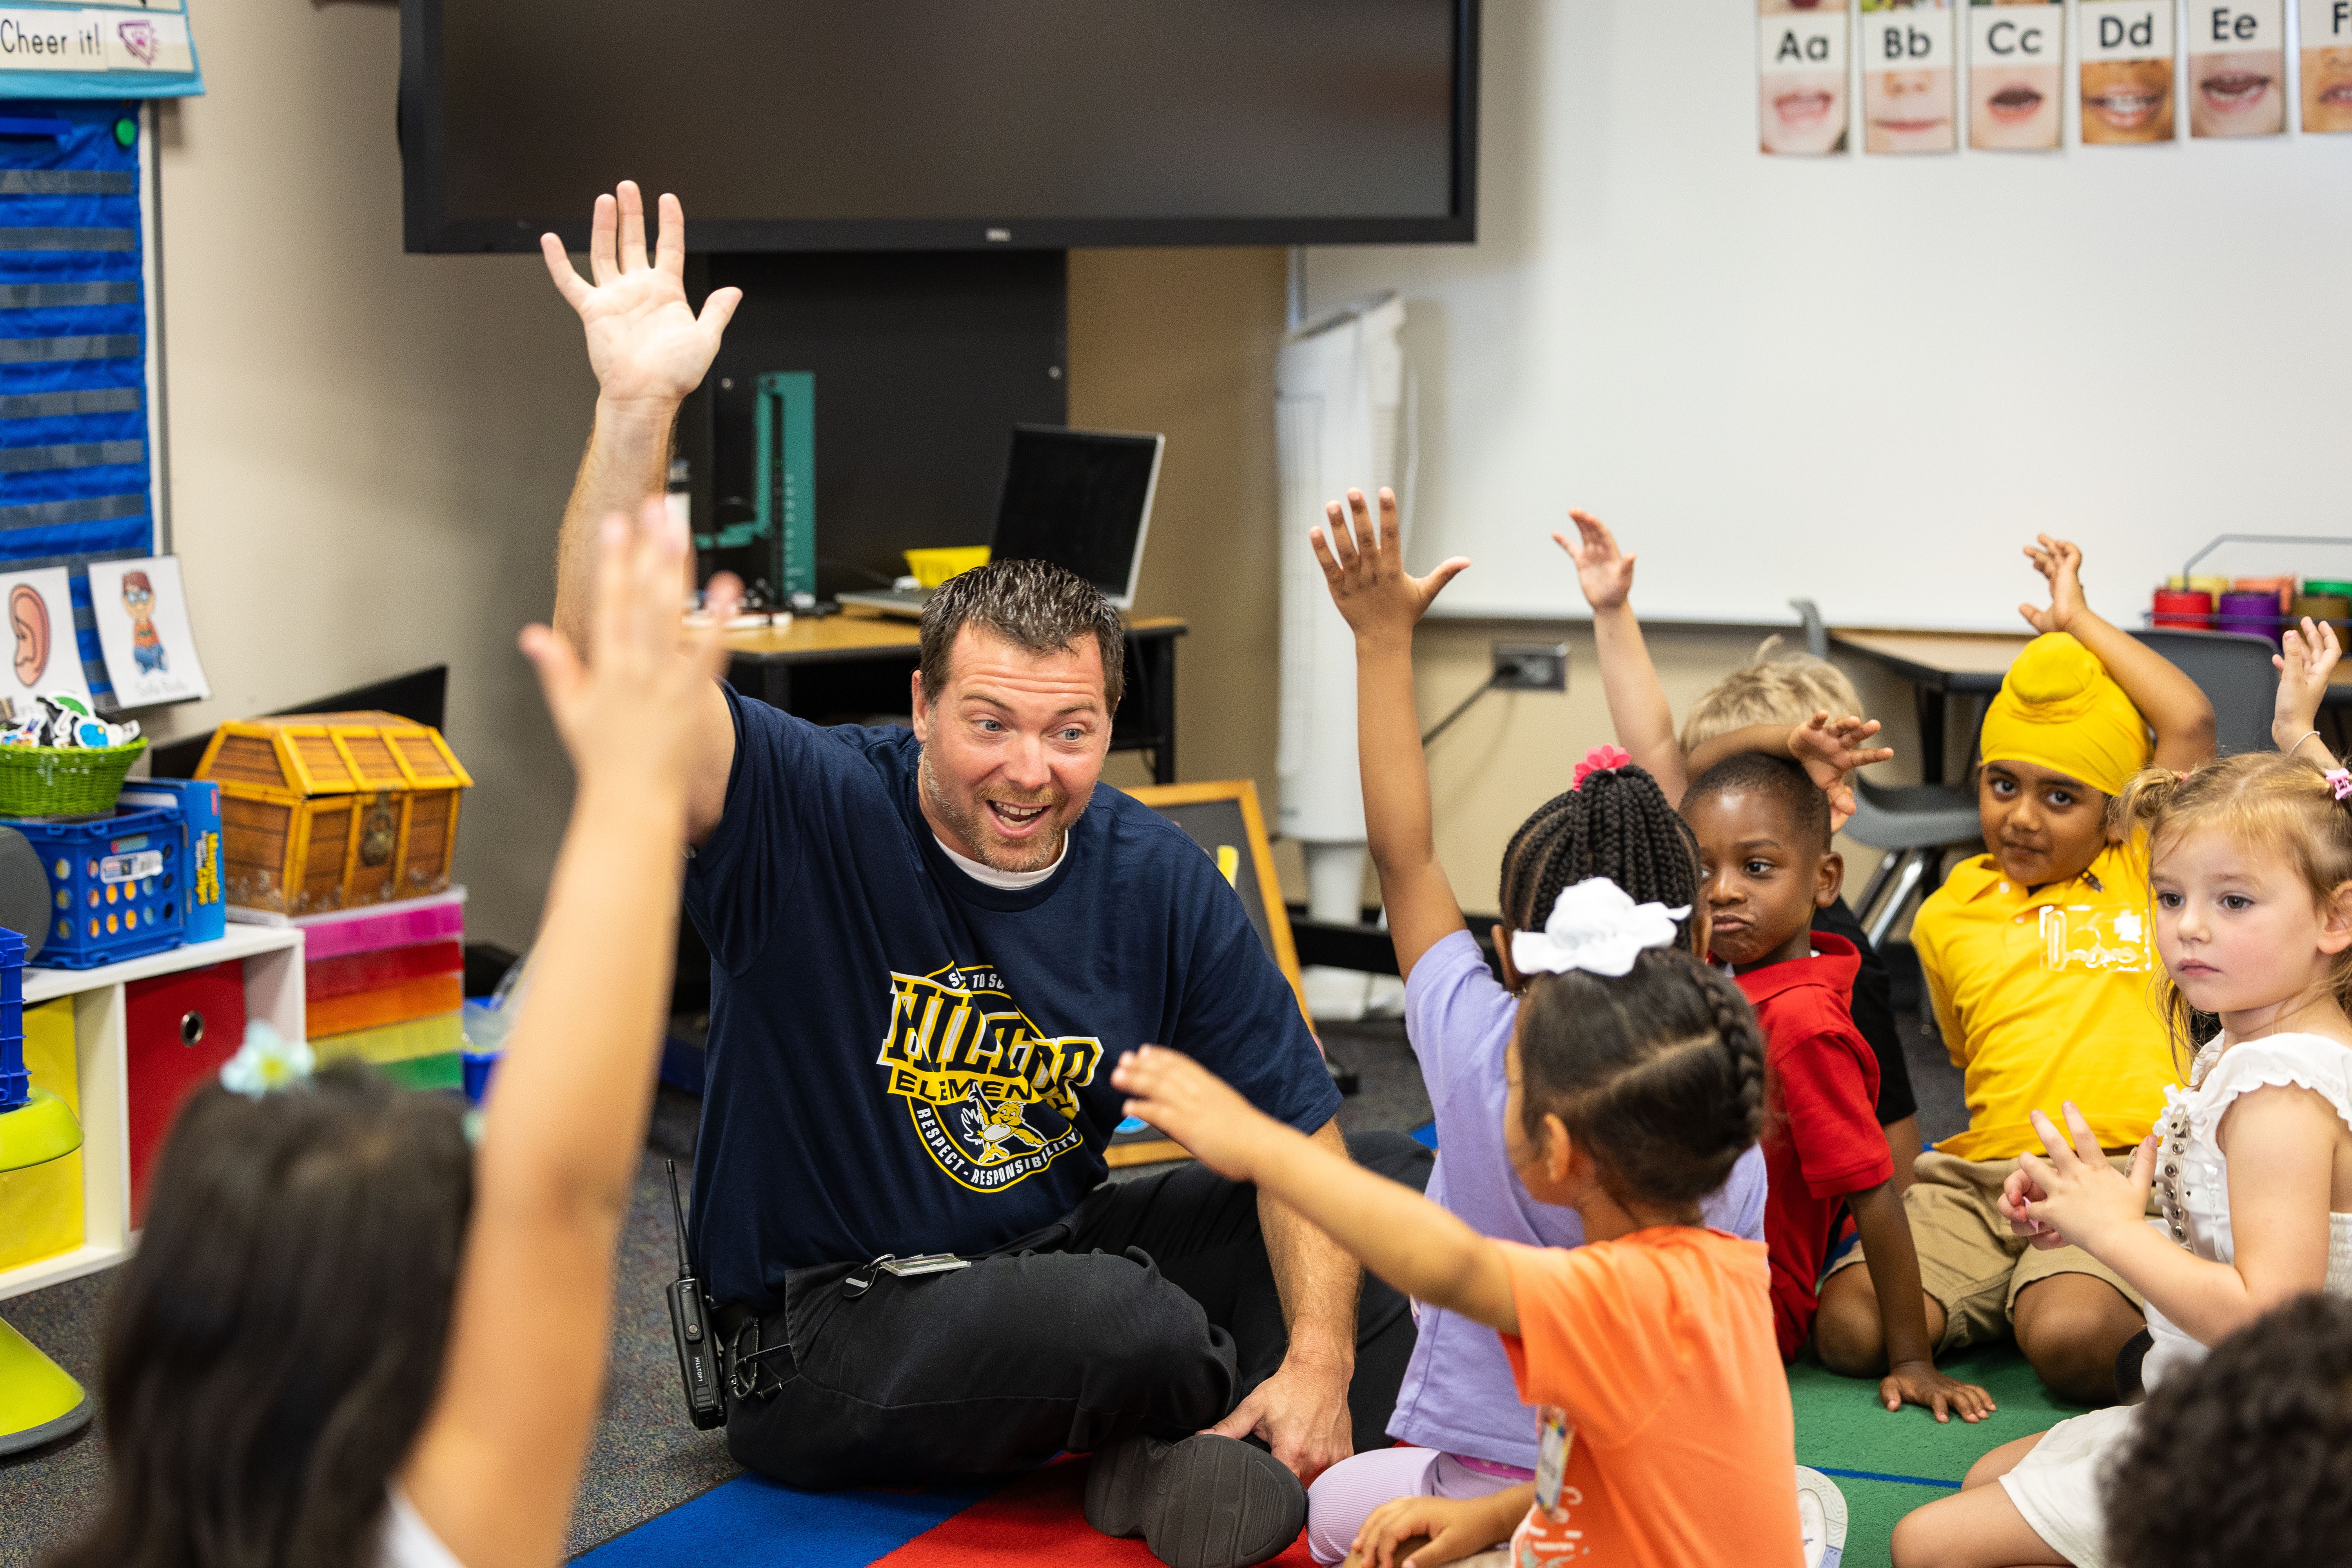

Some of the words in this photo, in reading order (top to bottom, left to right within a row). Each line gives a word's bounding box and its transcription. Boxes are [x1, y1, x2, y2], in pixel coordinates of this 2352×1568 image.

[2100, 12, 2153, 48] Dd
[2212, 7, 2258, 41] Ee
[2333, 1, 2352, 34] F
[1, 18, 67, 53] Cheer
[79, 22, 102, 55] it!
[1776, 29, 1829, 62] Aa
[1884, 24, 1932, 60] Bb
[1987, 20, 2042, 56] Cc
[973, 974, 985, 988] TO
[916, 1108, 965, 1171] RESPECT
[970, 1132, 1077, 1185] RESPONSIBILITY
[695, 1357, 703, 1381] HILLTOP1
